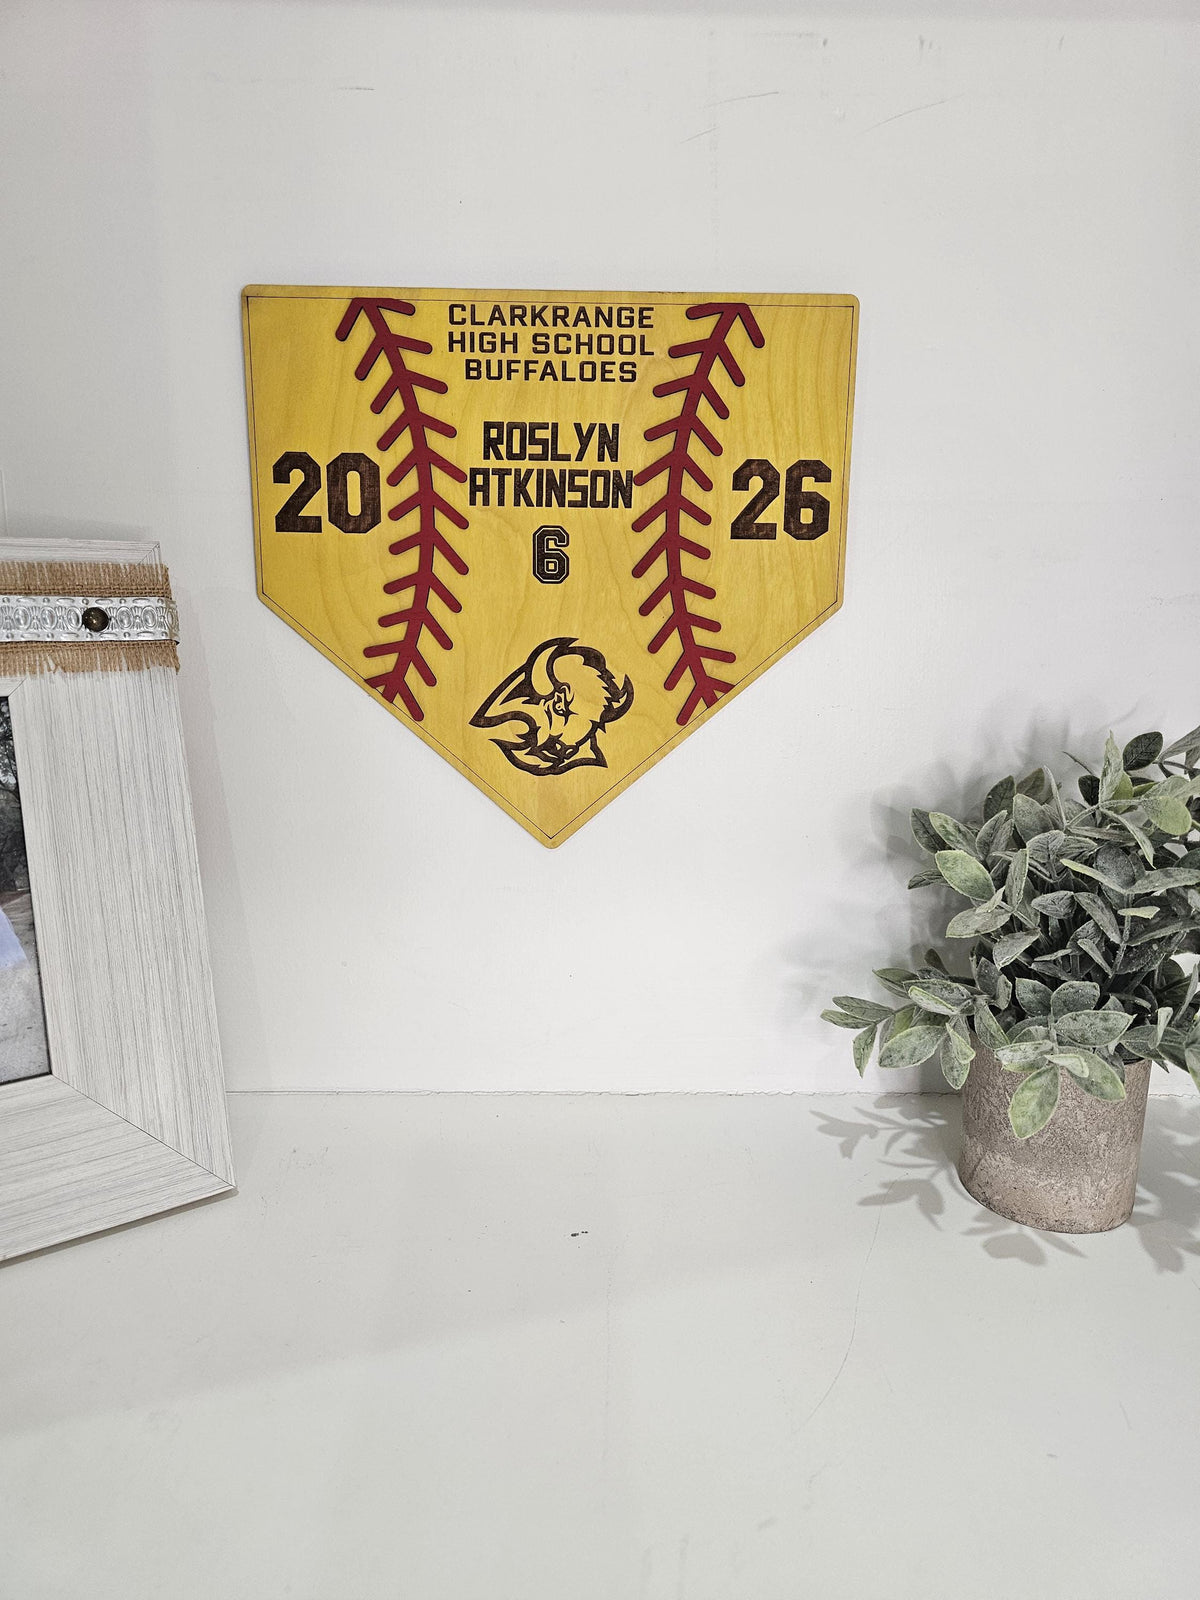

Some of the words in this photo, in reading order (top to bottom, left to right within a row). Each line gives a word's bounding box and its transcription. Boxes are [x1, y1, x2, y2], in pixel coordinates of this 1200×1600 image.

[448, 303, 655, 329] CLARKRANGE
[448, 331, 518, 354] HIGH
[532, 332, 655, 356] SCHOOL
[465, 358, 637, 383] BUFFALOES
[482, 420, 620, 463] ROSLYN
[272, 451, 382, 534] 20
[469, 467, 633, 509] ATKINSON
[730, 458, 832, 541] 26
[532, 524, 570, 585] 6
